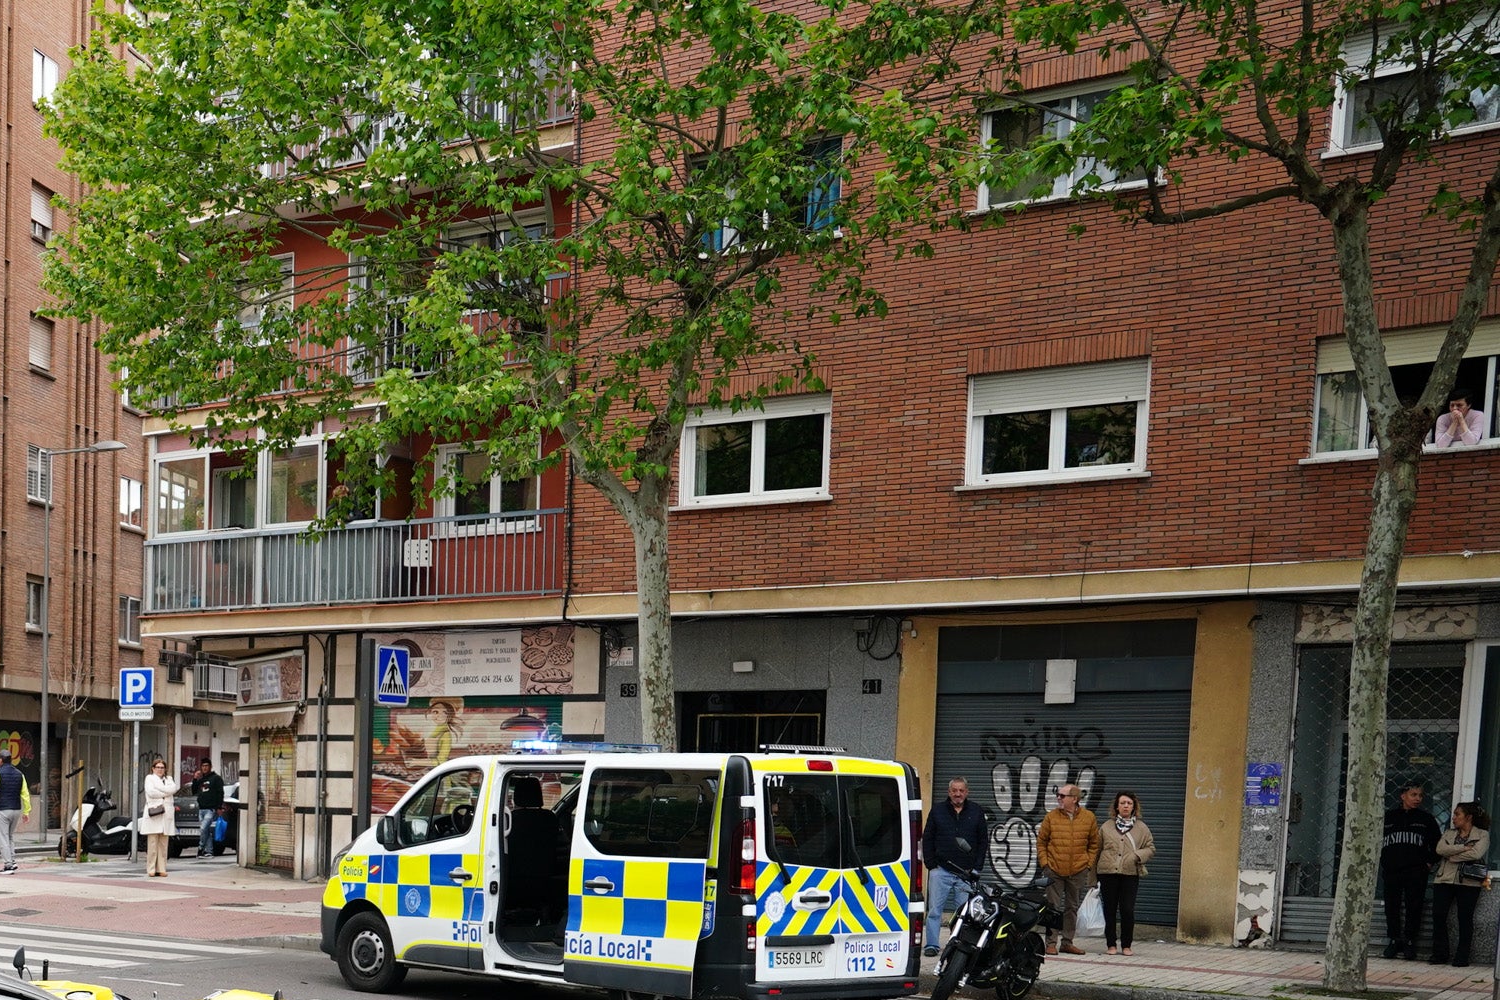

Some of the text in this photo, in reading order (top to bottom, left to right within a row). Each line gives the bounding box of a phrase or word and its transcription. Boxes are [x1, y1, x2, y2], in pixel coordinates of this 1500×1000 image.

[418, 659, 432, 669] ANA
[452, 675, 480, 685] ENCARGOS
[863, 680, 878, 693] 41
[126, 672, 147, 703] P
[621, 684, 636, 697] 39
[765, 775, 785, 788] 717
[462, 923, 482, 942] Pol
[598, 936, 641, 960] Local
[878, 940, 901, 953] Local
[775, 951, 823, 965] 5569 LRC
